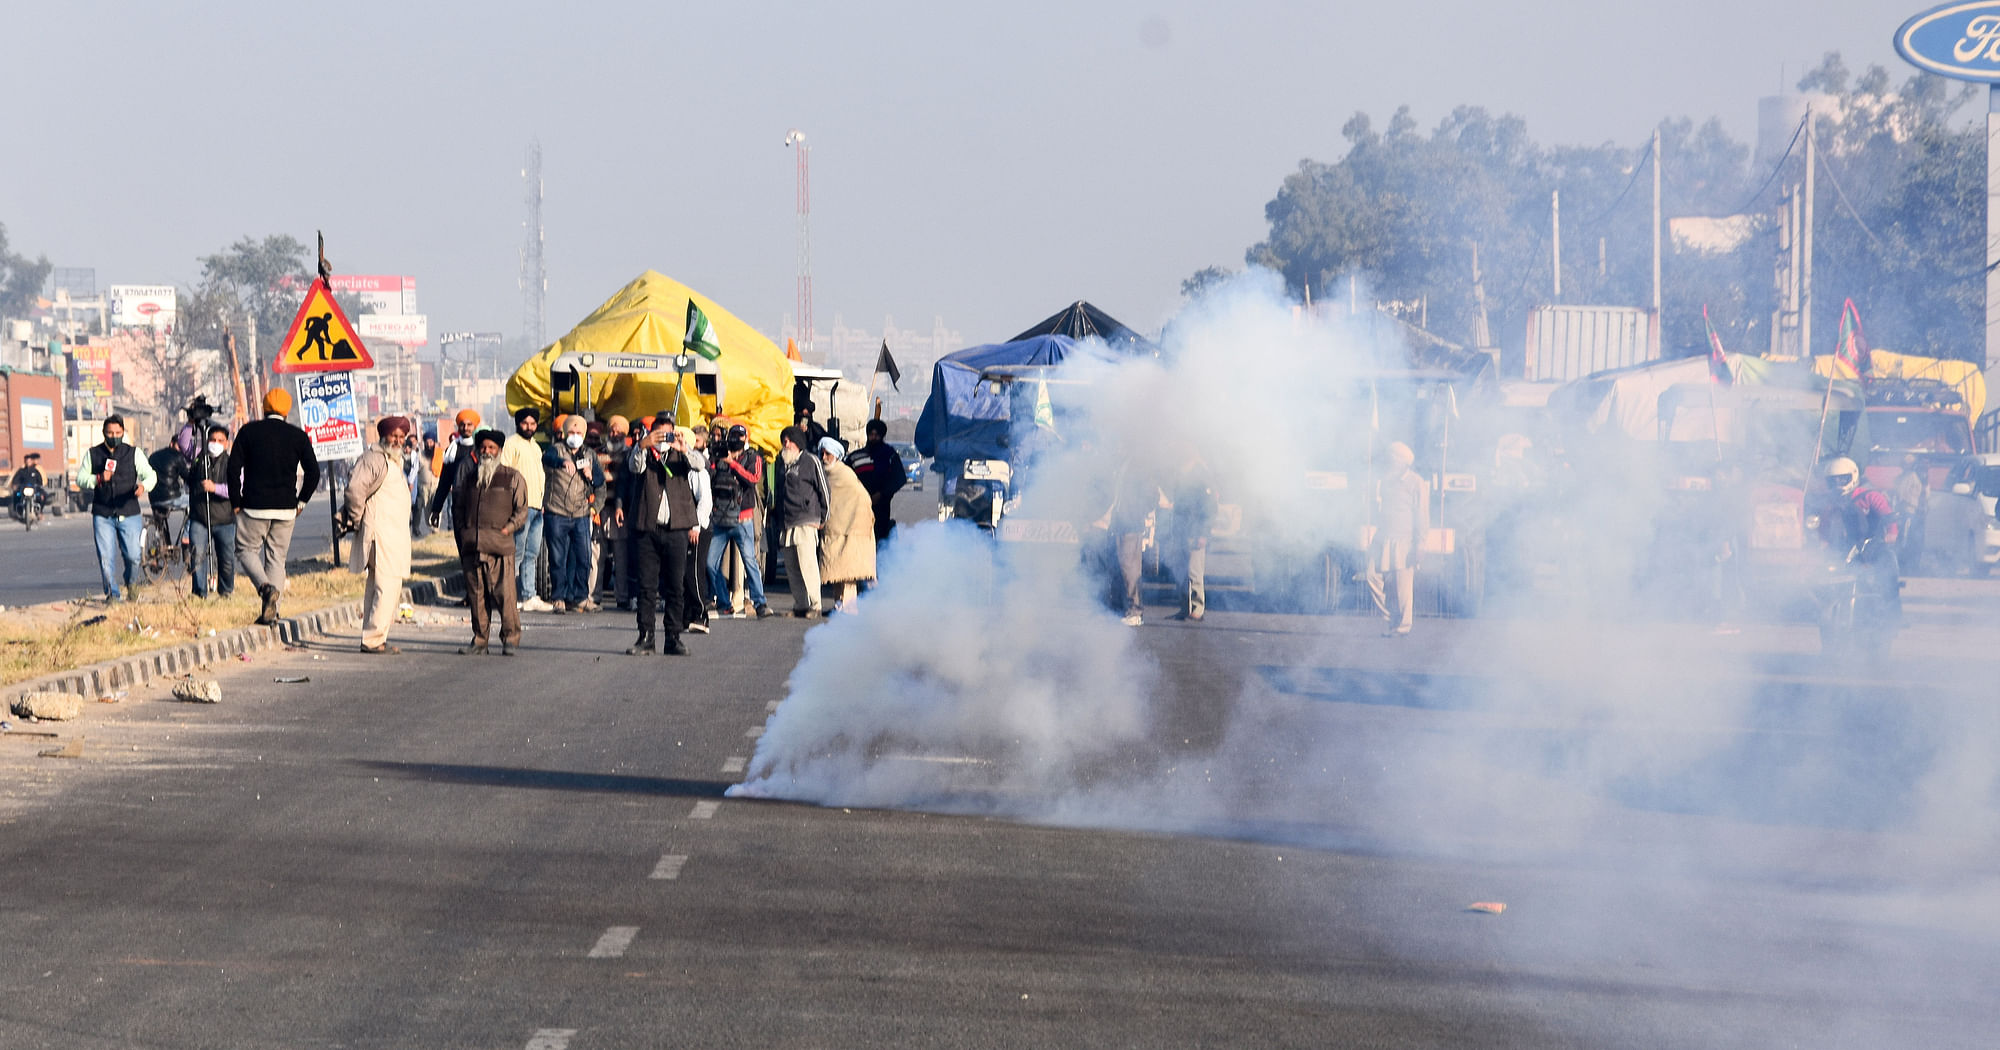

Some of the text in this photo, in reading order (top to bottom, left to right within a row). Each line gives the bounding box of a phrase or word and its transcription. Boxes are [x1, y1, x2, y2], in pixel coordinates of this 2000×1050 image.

[73, 347, 110, 360] RTO TAX
[77, 360, 106, 369] ONLINE
[301, 381, 348, 399] Reebok
[303, 405, 327, 425] 70%
[330, 406, 353, 418] OPEN
[316, 424, 354, 435] Minute
